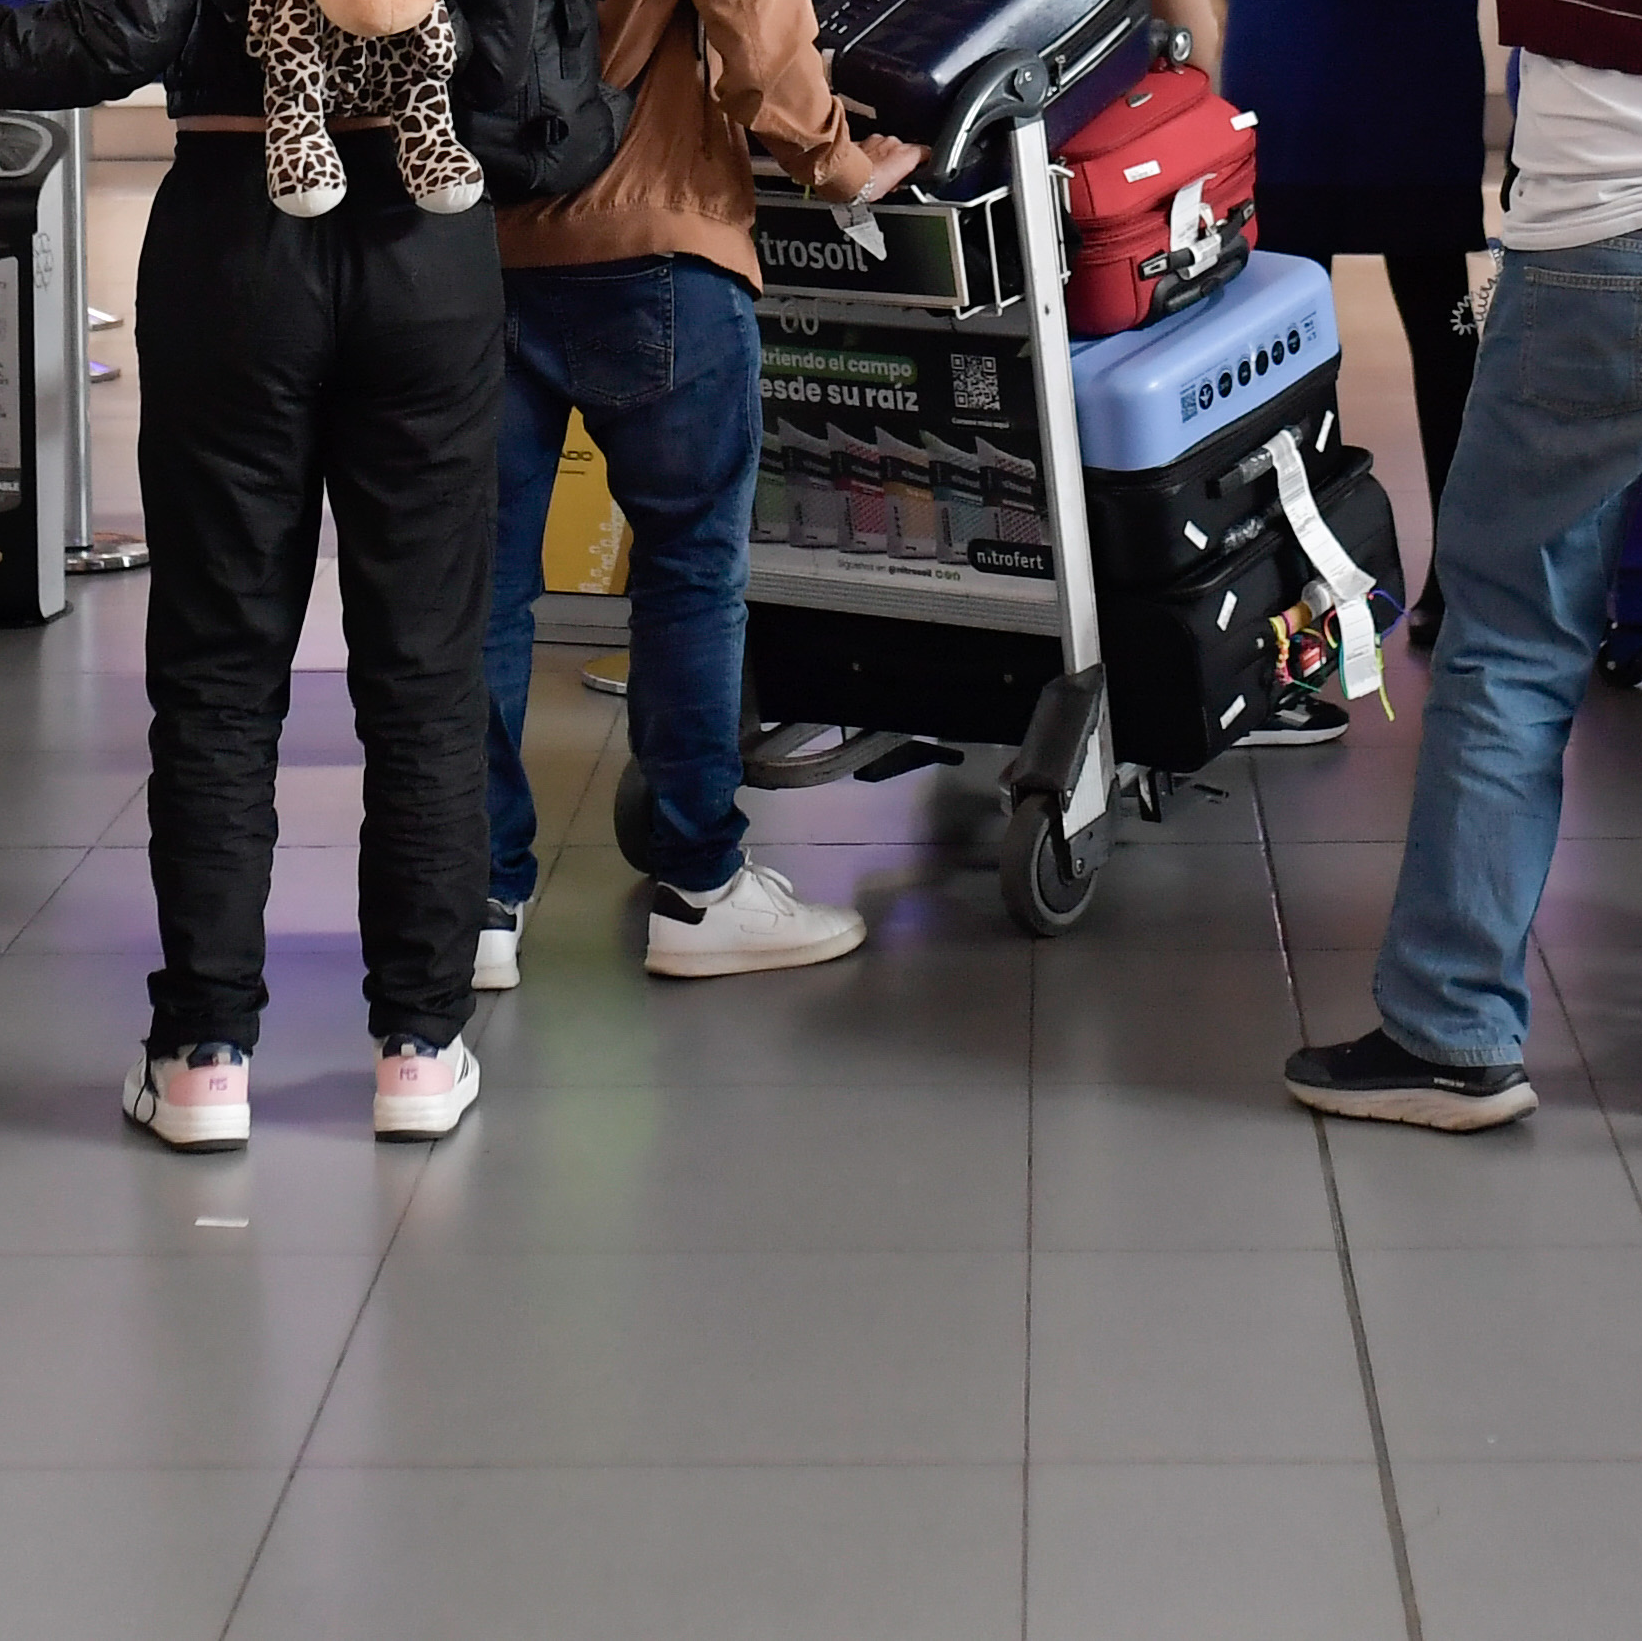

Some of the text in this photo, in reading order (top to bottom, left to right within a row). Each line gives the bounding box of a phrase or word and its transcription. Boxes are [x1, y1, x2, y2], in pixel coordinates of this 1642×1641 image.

[828, 354, 845, 371] el
[847, 359, 912, 381] campo
[760, 376, 919, 412] esde su raíz
